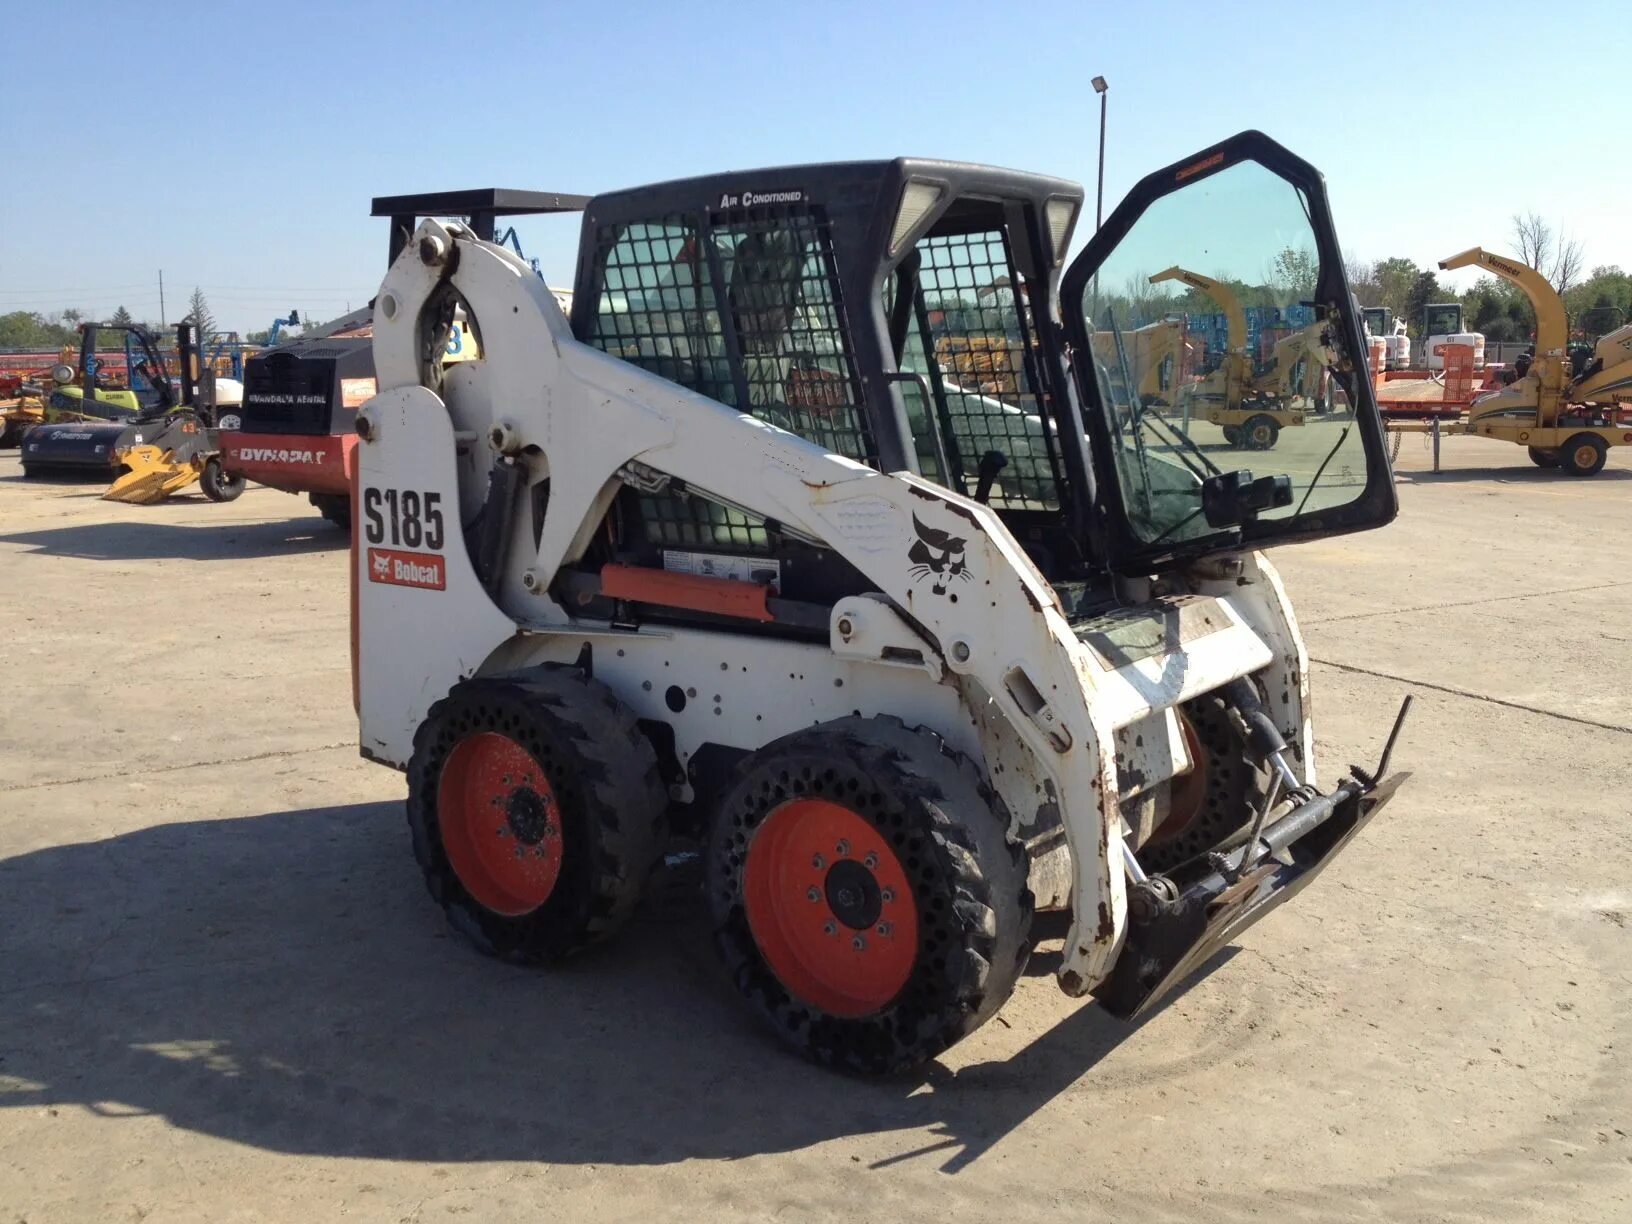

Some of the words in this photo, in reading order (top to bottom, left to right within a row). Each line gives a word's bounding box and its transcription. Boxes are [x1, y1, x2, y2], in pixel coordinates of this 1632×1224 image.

[1487, 255, 1521, 277] Vermeer
[364, 487, 444, 550] S185
[394, 559, 440, 584] Bobcat
